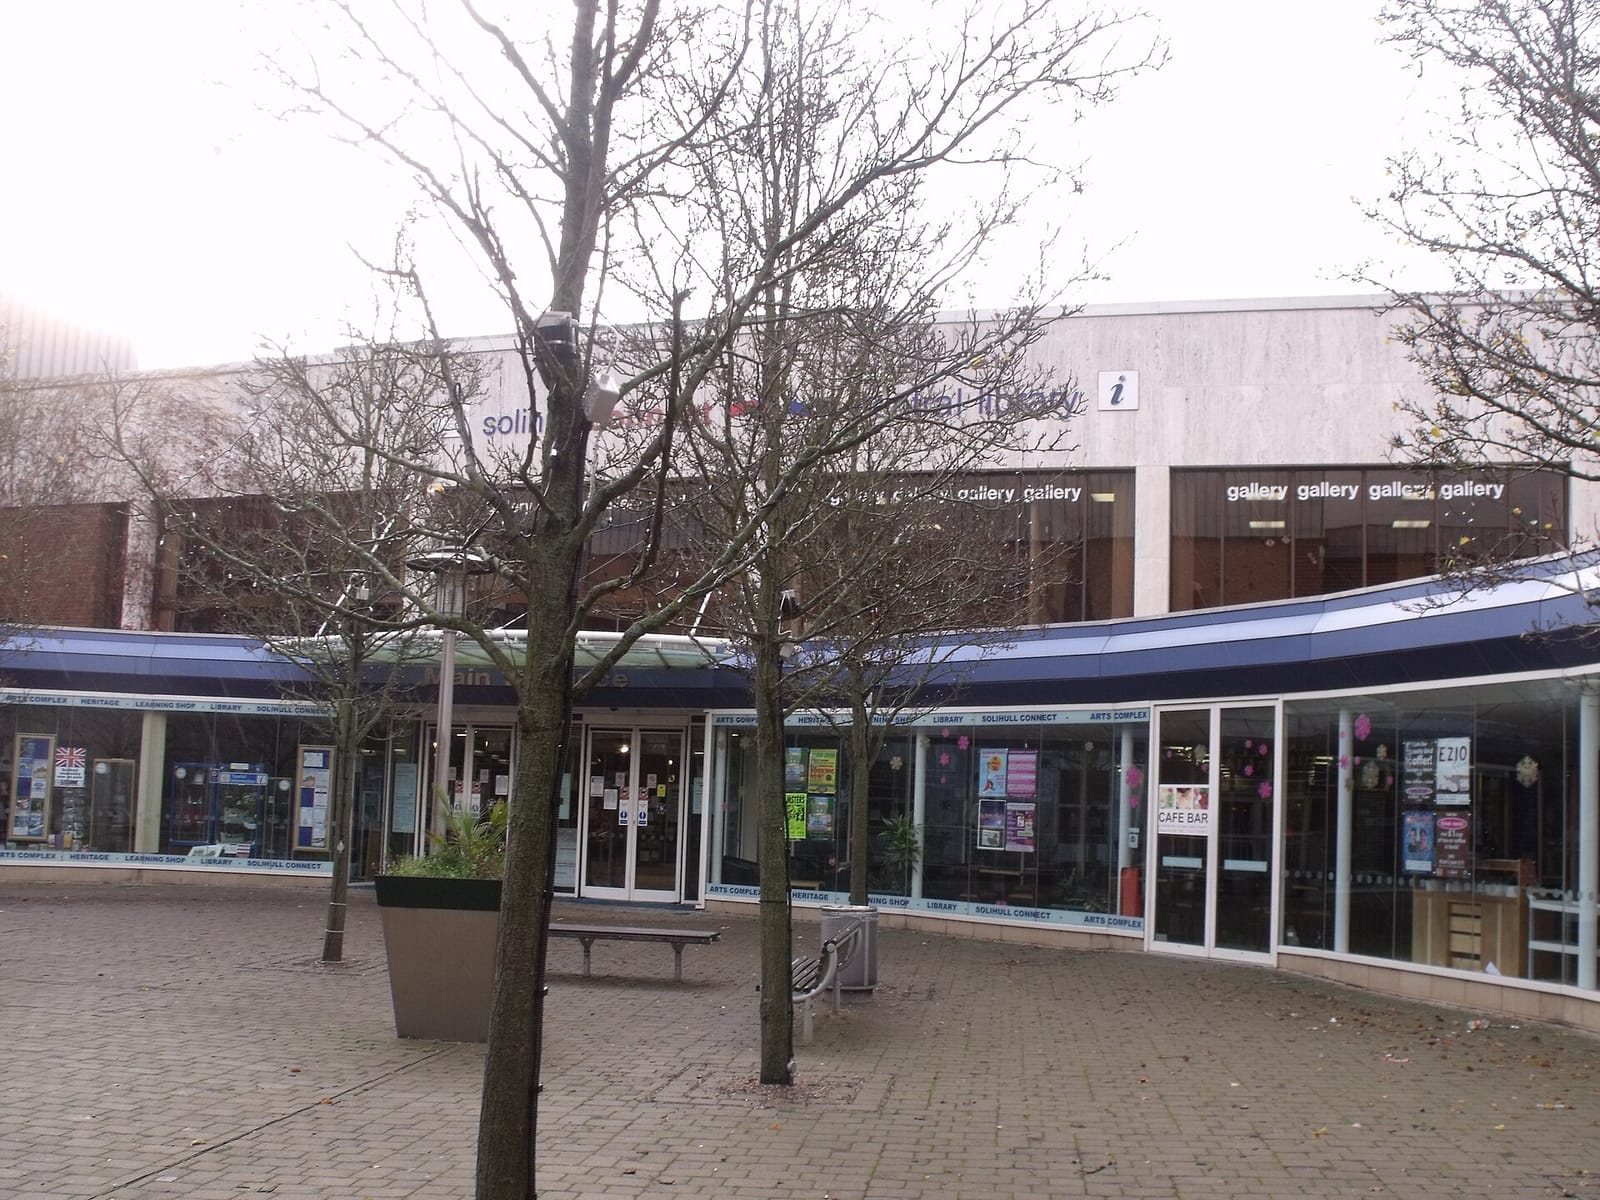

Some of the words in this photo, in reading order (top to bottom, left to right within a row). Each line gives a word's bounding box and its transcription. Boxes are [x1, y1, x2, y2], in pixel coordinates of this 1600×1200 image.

[1024, 484, 1082, 502] gallery
[1227, 482, 1288, 501] gallery
[1297, 481, 1359, 500] gallery
[1441, 481, 1504, 499] gallery
[29, 696, 68, 704] COMPLEX
[81, 698, 120, 706] HERITAGE
[135, 701, 174, 709] LEARNING
[256, 705, 293, 713] SOLIHULL
[716, 716, 734, 724] ARTS
[982, 714, 1018, 722] SOLIHULL
[1020, 713, 1057, 722] CONNECT
[1113, 711, 1148, 719] COMPLEX
[1158, 812, 1184, 823] CAFE
[1187, 812, 1208, 824] BAR
[125, 855, 164, 863] LEARNING
[247, 860, 284, 868] SOLIHULL
[792, 892, 829, 901] HERITAGE
[889, 898, 910, 907] SHOP
[927, 902, 957, 911] LIBRARY
[975, 906, 1012, 916] SOLIHULL
[1013, 909, 1051, 919] CONNECT
[1084, 916, 1106, 924] ARTS
[1108, 917, 1142, 928] COMPLEX
